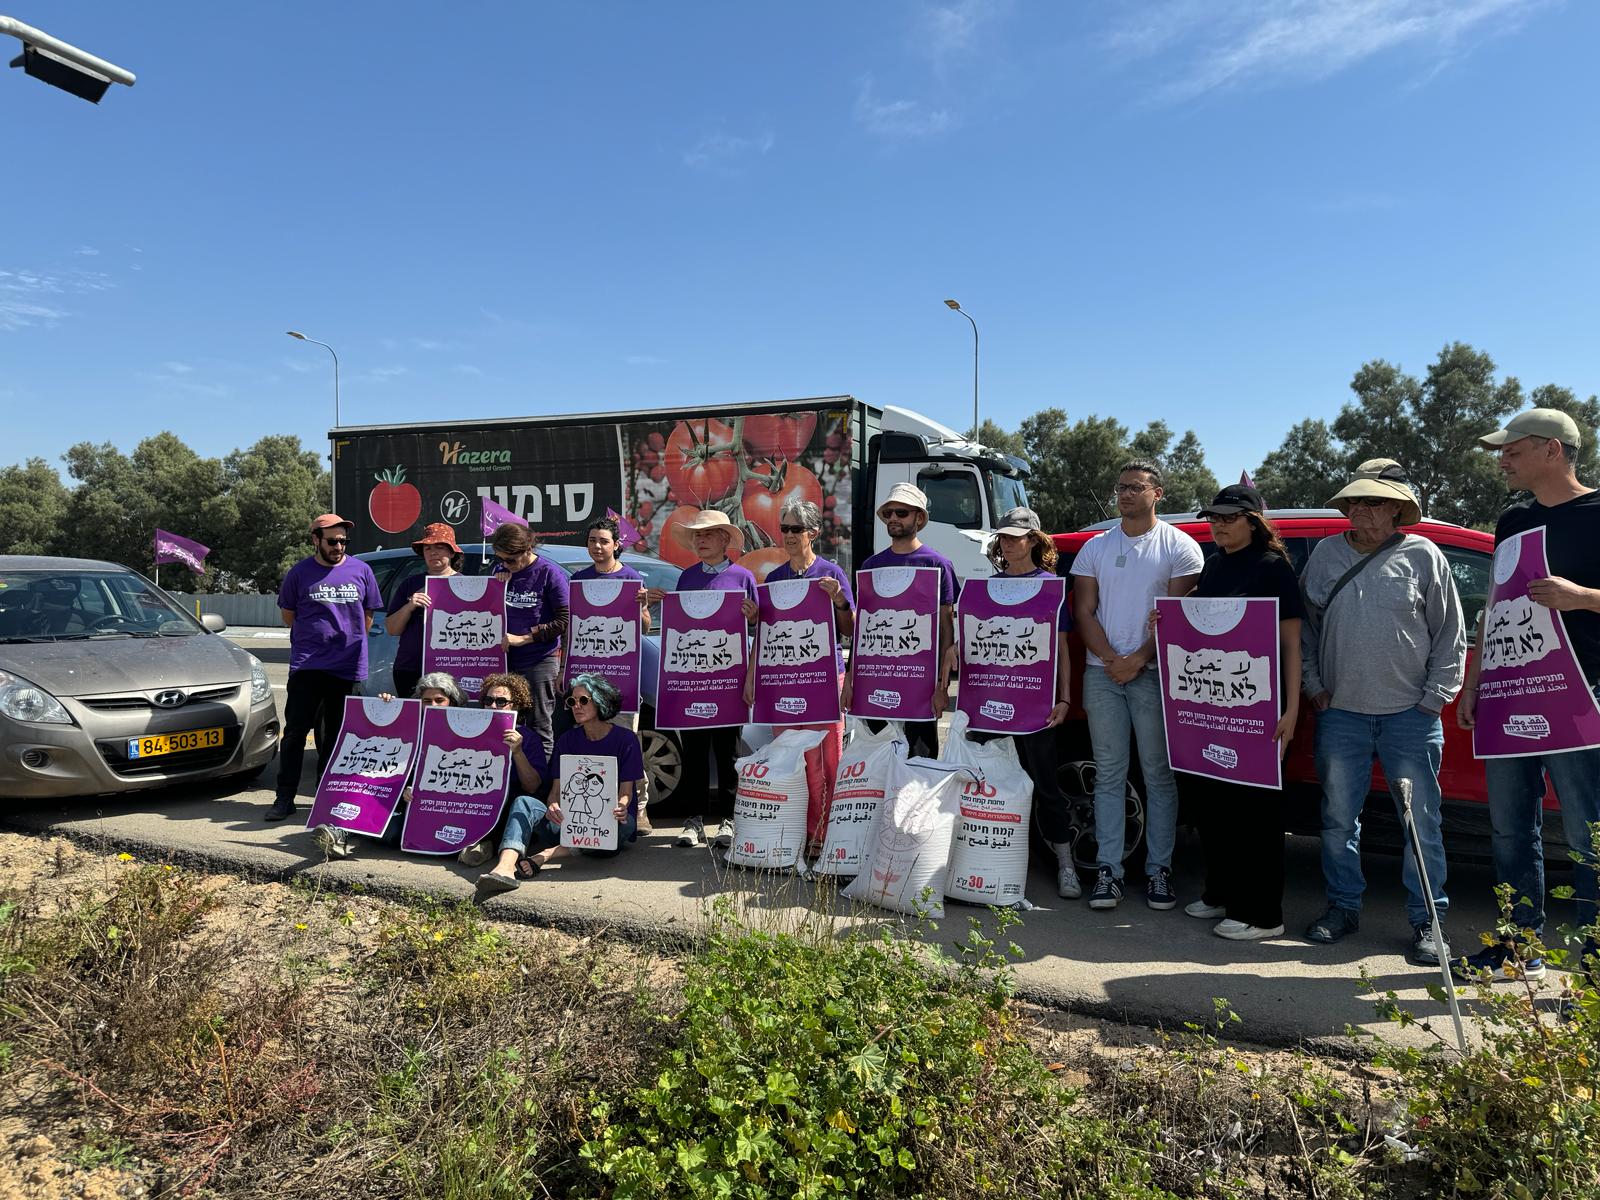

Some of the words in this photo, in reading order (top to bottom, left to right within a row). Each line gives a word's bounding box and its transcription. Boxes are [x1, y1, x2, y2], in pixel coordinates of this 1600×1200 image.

[439, 441, 512, 464] Hazera
[1517, 607, 1533, 625] لا
[482, 618, 493, 627] لا
[900, 618, 916, 630] لا
[610, 624, 623, 634] لا
[800, 628, 814, 639] لا
[1016, 626, 1034, 638] لا
[713, 637, 727, 648] لا
[1230, 661, 1250, 675] لا
[1011, 675, 1042, 683] מתגייסים
[1527, 673, 1565, 684] מתגייסים
[1230, 718, 1264, 726] מתגייסים
[386, 746, 402, 755] لا
[478, 759, 492, 769] لا
[973, 797, 986, 805] קמח
[760, 803, 780, 812] קמח
[855, 802, 876, 812] קמח
[837, 812, 851, 824] قمح
[853, 812, 872, 823] دقيق
[567, 825, 588, 835] STOP
[963, 822, 988, 834] חיטה
[993, 826, 1014, 837] קמח
[969, 836, 988, 847] قمح
[991, 838, 1010, 849] دقيق
[744, 842, 754, 853] 30
[836, 848, 846, 859] 30
[969, 876, 983, 888] 30
